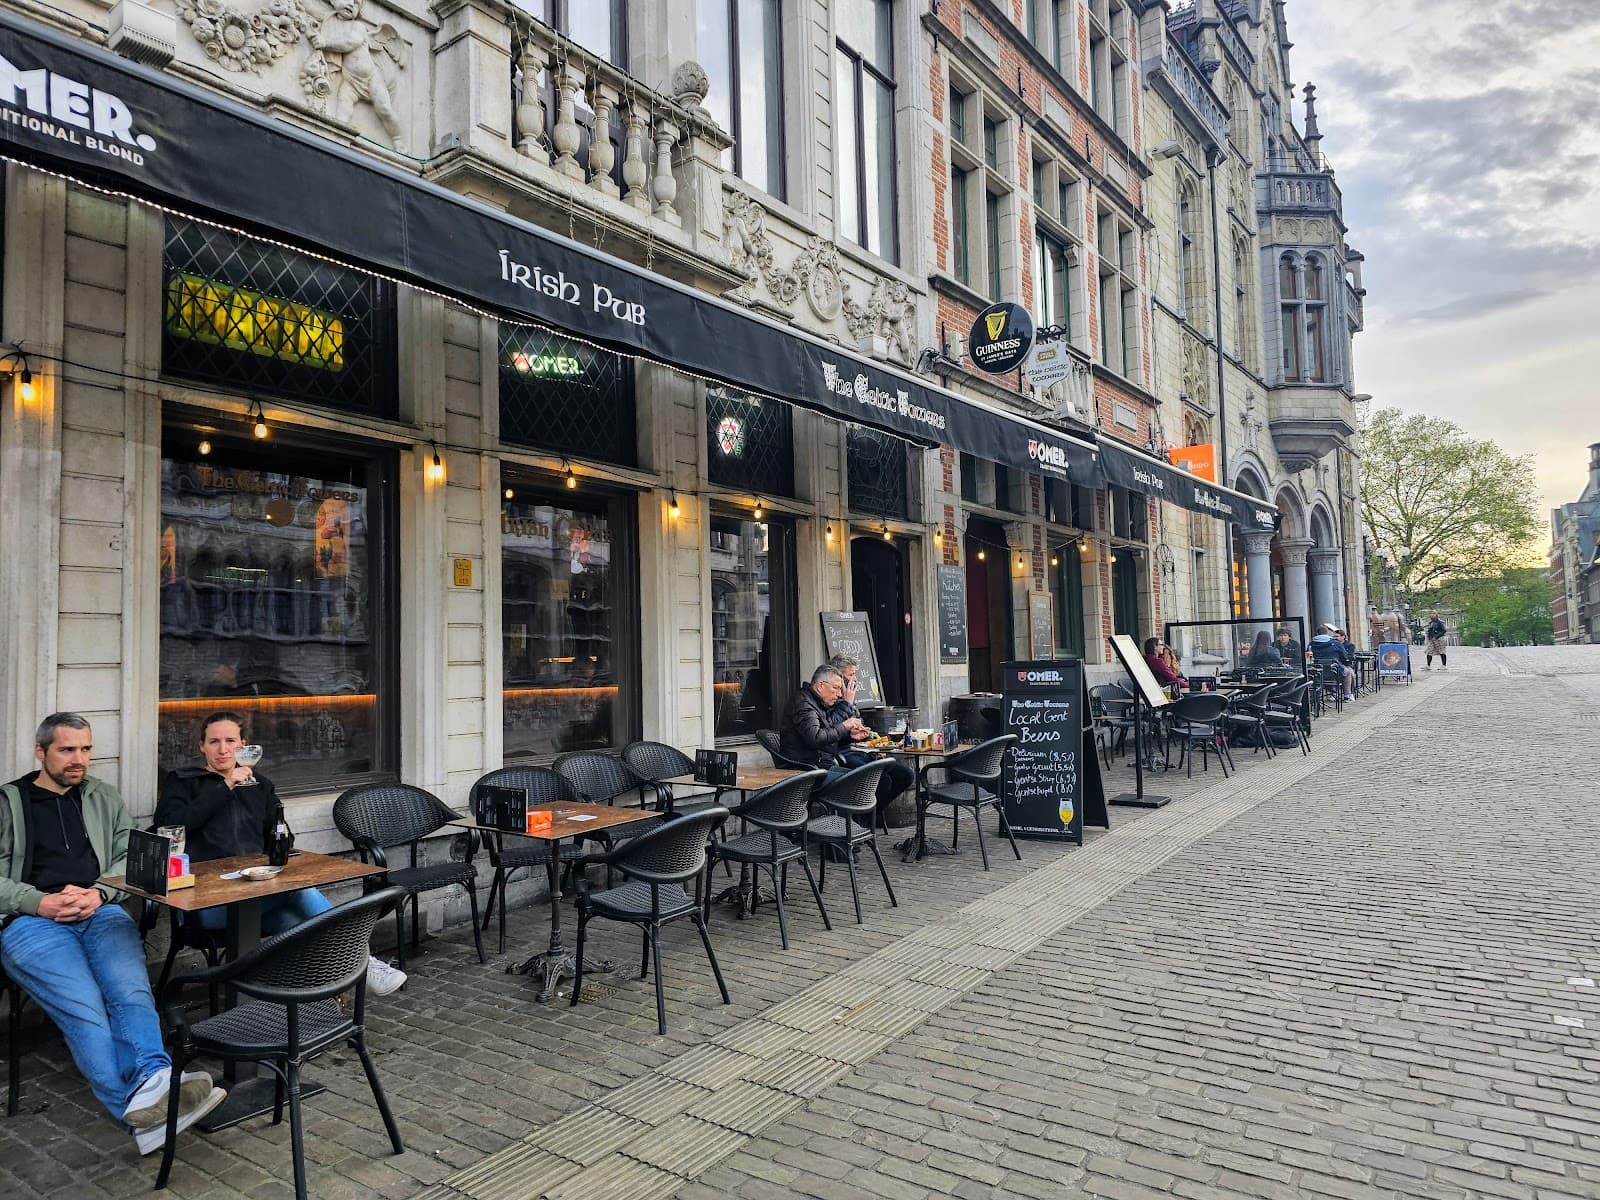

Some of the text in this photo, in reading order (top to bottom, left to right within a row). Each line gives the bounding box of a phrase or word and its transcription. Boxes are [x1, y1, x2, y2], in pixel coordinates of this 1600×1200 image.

[0, 54, 157, 151] MER.
[85, 135, 144, 166] BLOND
[975, 338, 1021, 357] GUINNESS
[1037, 442, 1069, 468] OMER.
[1027, 671, 1063, 681] OMER.
[1019, 727, 1061, 744] Beers
